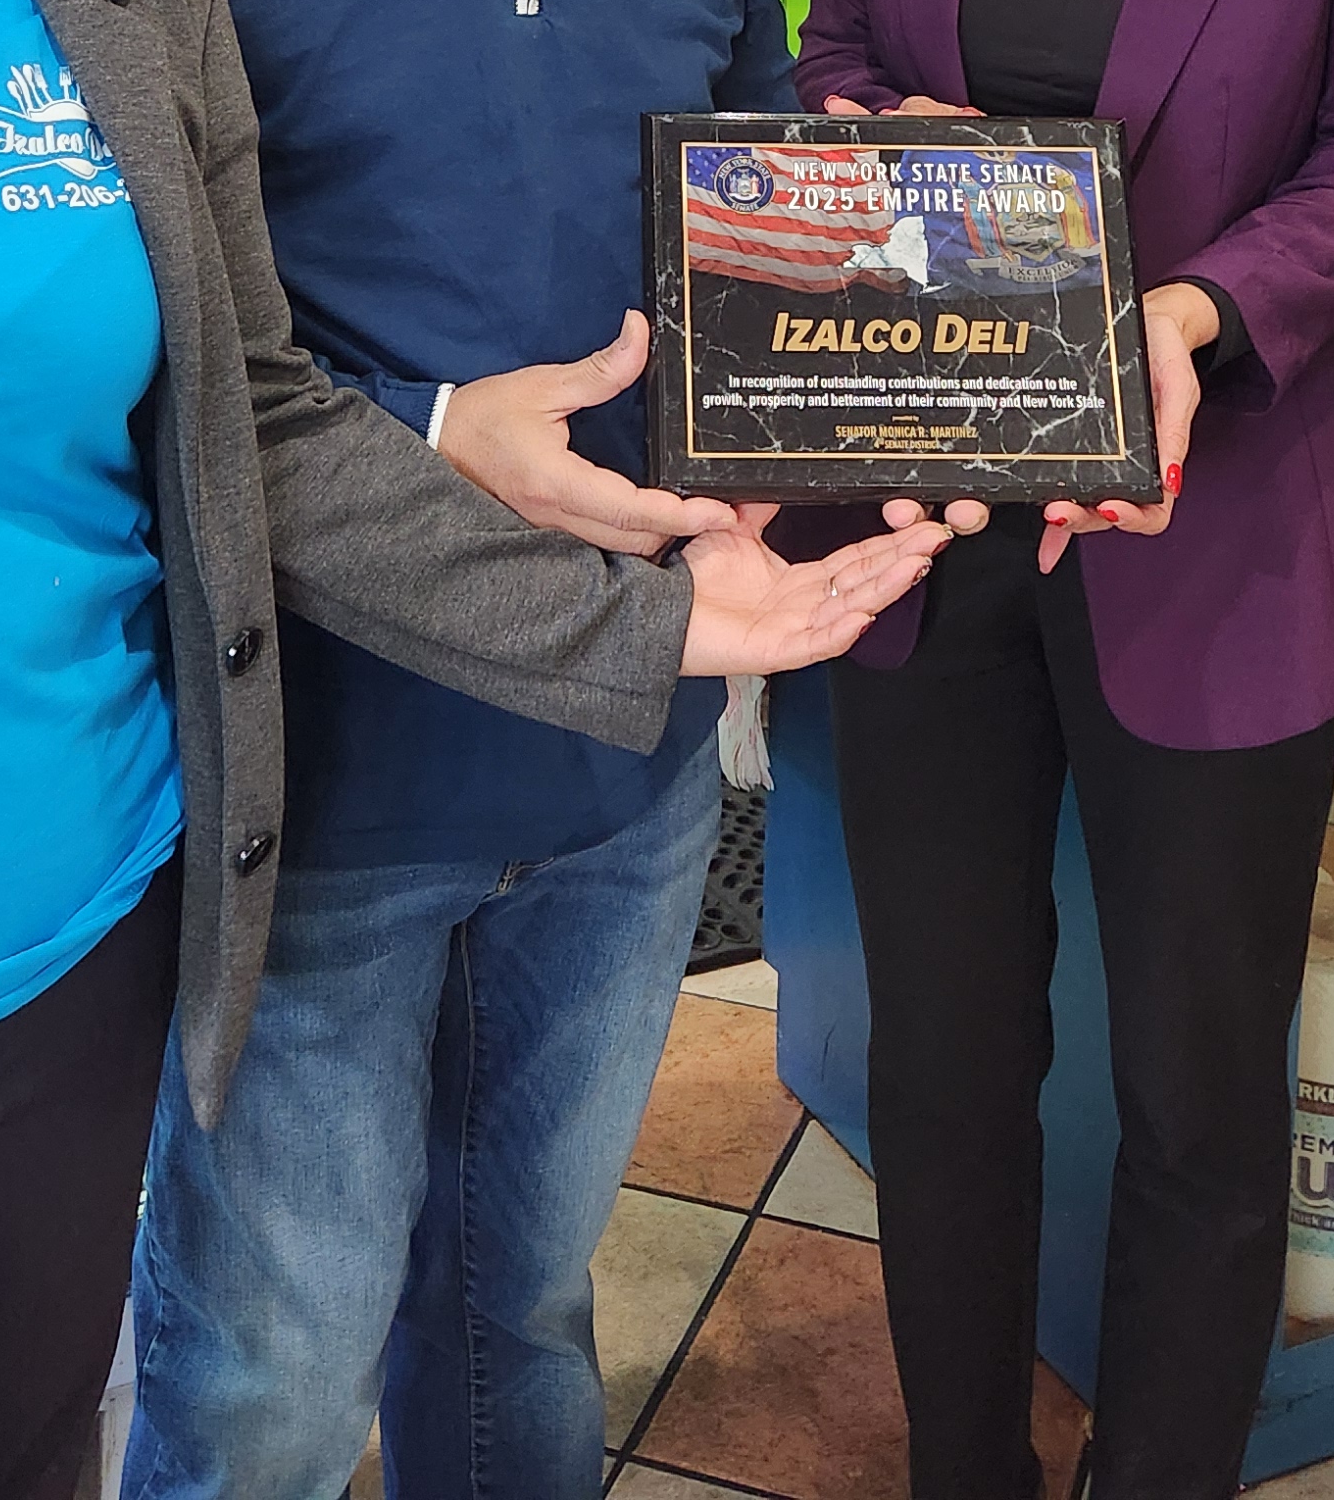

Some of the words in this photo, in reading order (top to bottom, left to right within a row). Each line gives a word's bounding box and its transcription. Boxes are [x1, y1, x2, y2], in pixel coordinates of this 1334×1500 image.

[793, 161, 837, 182] NEW
[845, 162, 903, 183] YORK
[912, 162, 971, 183] STATE
[980, 163, 1057, 184] SENATE
[786, 186, 855, 212] 2025
[867, 186, 965, 213] EMPIRE
[977, 189, 1066, 214] AWARD
[771, 311, 922, 354] IZALCO
[932, 313, 1030, 354] DELI
[728, 374, 740, 389] In
[742, 374, 805, 392] recognition
[807, 374, 819, 389] of
[821, 375, 887, 392] outstanding
[888, 376, 961, 390] contributions
[962, 376, 984, 390] and
[985, 376, 1044, 391] dedication
[1045, 378, 1057, 391] to
[1058, 377, 1078, 391] the
[702, 393, 747, 409] growth,
[749, 393, 806, 410] prosperity
[807, 394, 830, 407] and
[831, 393, 893, 408] betterment
[895, 394, 908, 407] of
[908, 394, 935, 408] their
[936, 394, 997, 411] community
[1000, 395, 1020, 408] and
[1022, 395, 1047, 408] New
[1049, 395, 1075, 409] York
[1076, 395, 1106, 409] State
[835, 425, 877, 438] SENATOR
[878, 426, 917, 439] MONICA
[918, 427, 928, 438] R.
[930, 426, 978, 439] MARTINEZ
